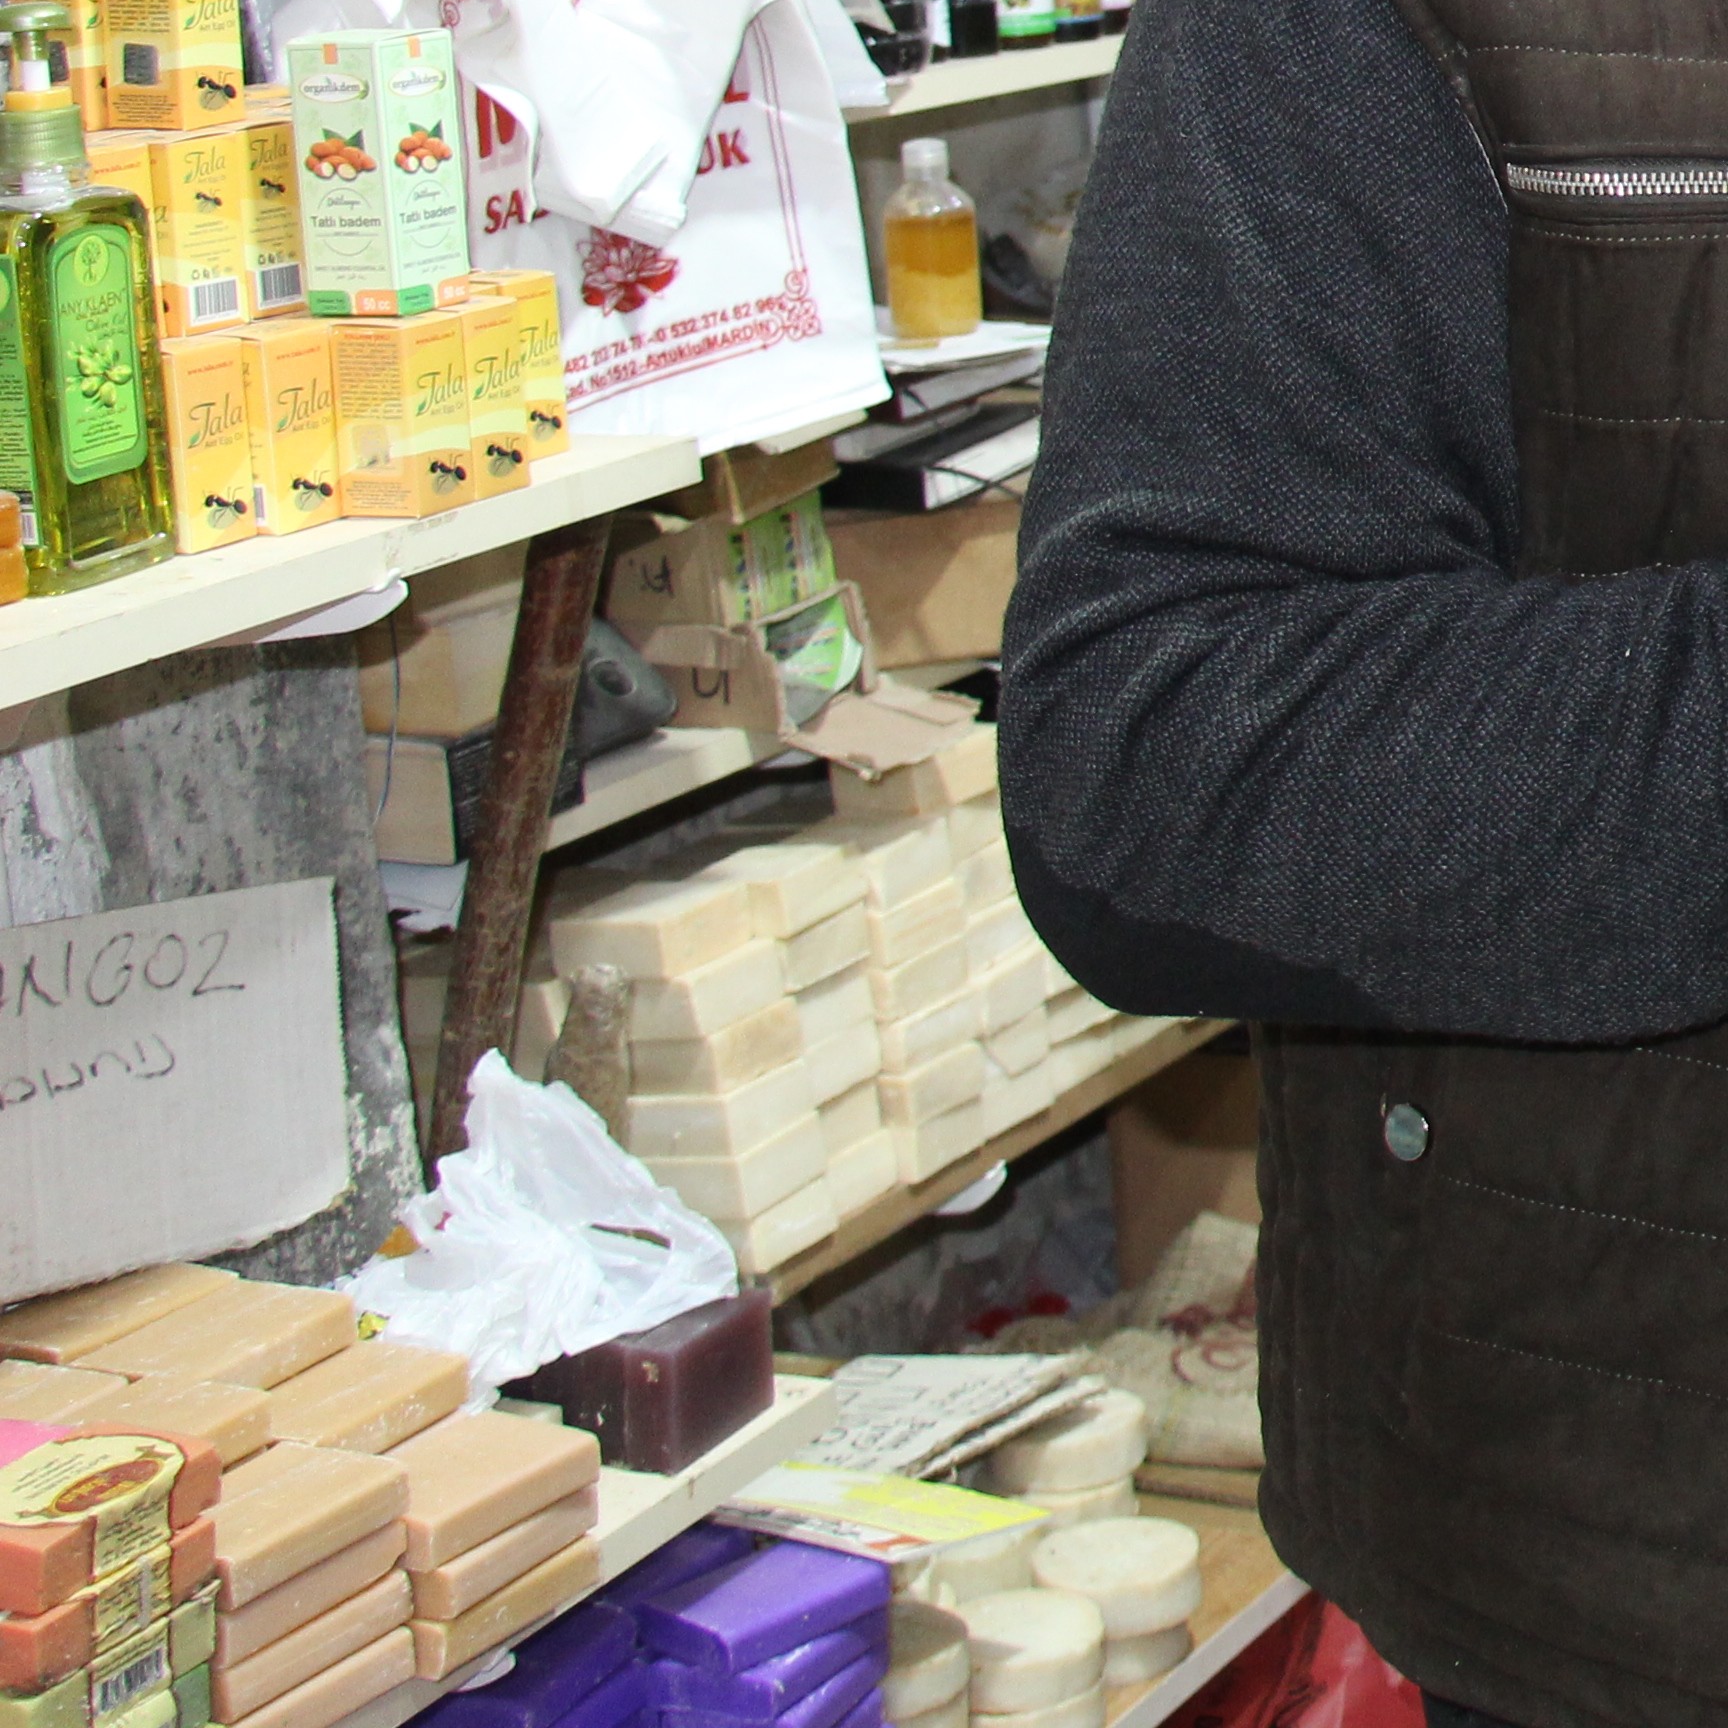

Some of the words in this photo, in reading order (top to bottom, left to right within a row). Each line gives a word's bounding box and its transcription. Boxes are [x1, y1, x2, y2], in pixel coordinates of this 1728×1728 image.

[184, 146, 226, 184] Tala
[251, 133, 288, 170] Tala
[340, 215, 381, 228] badem
[423, 204, 457, 221] badem
[483, 188, 551, 235] SA
[363, 298, 378, 311] 50
[519, 319, 560, 368] Tala
[671, 318, 697, 339] 532
[416, 362, 464, 417] Tala
[473, 347, 520, 400] Tala
[188, 392, 244, 449] Tala
[276, 377, 332, 433] Tala
